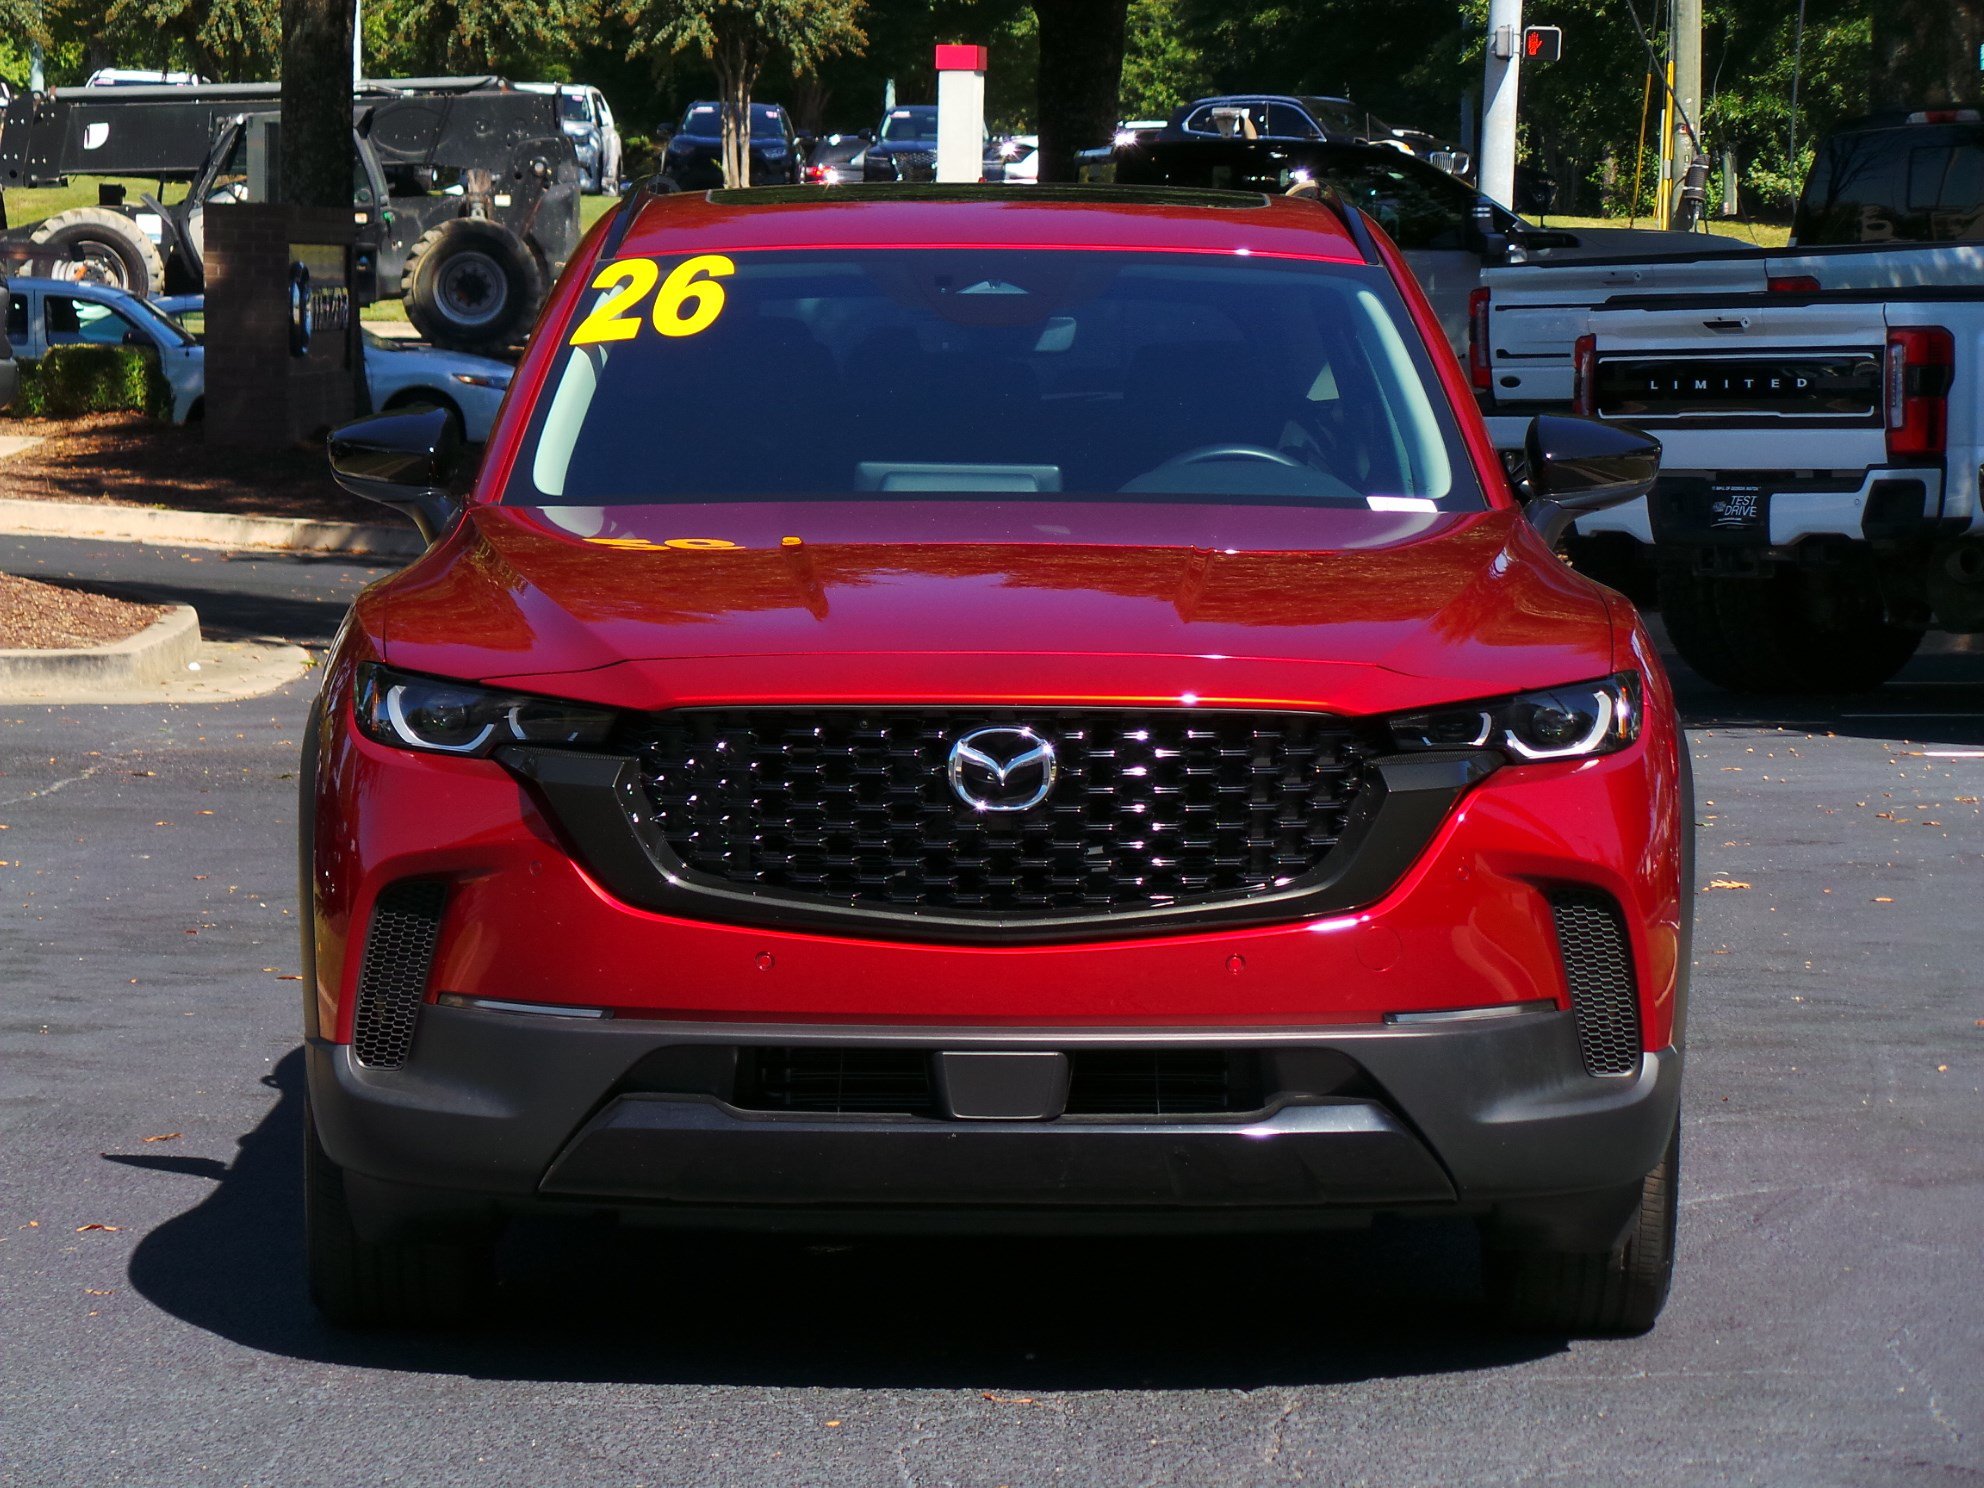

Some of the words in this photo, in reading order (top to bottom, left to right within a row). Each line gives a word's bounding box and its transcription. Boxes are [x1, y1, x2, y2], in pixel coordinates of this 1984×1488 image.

[569, 254, 735, 345] 26
[1650, 378, 1808, 390] LIMITED
[1731, 495, 1757, 506] TEST
[1724, 505, 1757, 517] DRIVE
